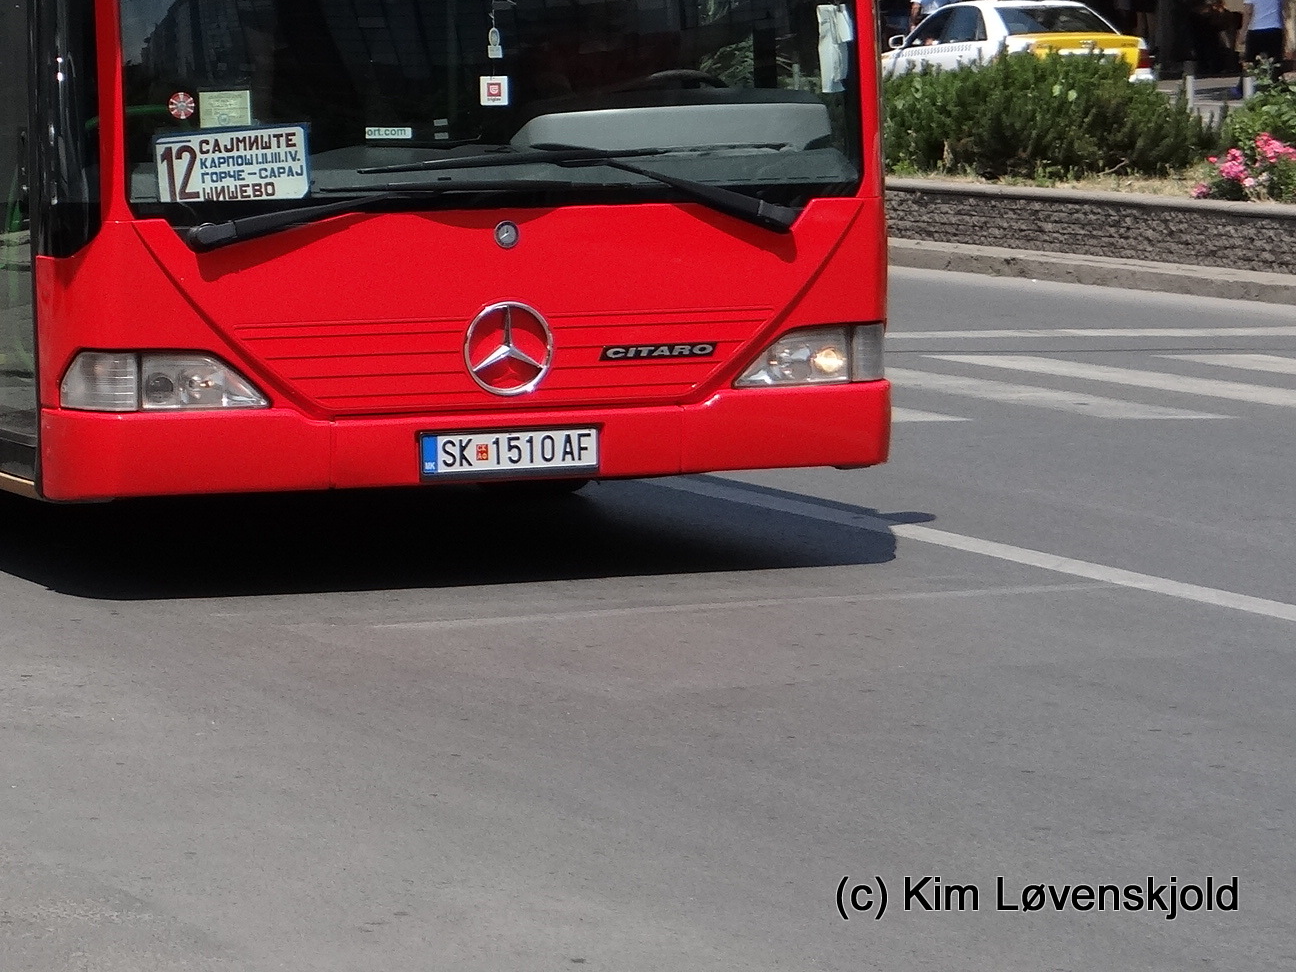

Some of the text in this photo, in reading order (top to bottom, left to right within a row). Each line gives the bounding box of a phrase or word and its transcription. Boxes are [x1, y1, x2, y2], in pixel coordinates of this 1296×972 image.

[198, 132, 297, 155] САЈМИШТЕ
[199, 154, 254, 170] КАРПОШ
[259, 164, 304, 180] САРАЈ
[160, 144, 200, 202] 12
[202, 181, 276, 201] ШИШЕВО
[606, 344, 714, 359] CITARO
[441, 432, 592, 468] SK 1510 AF
